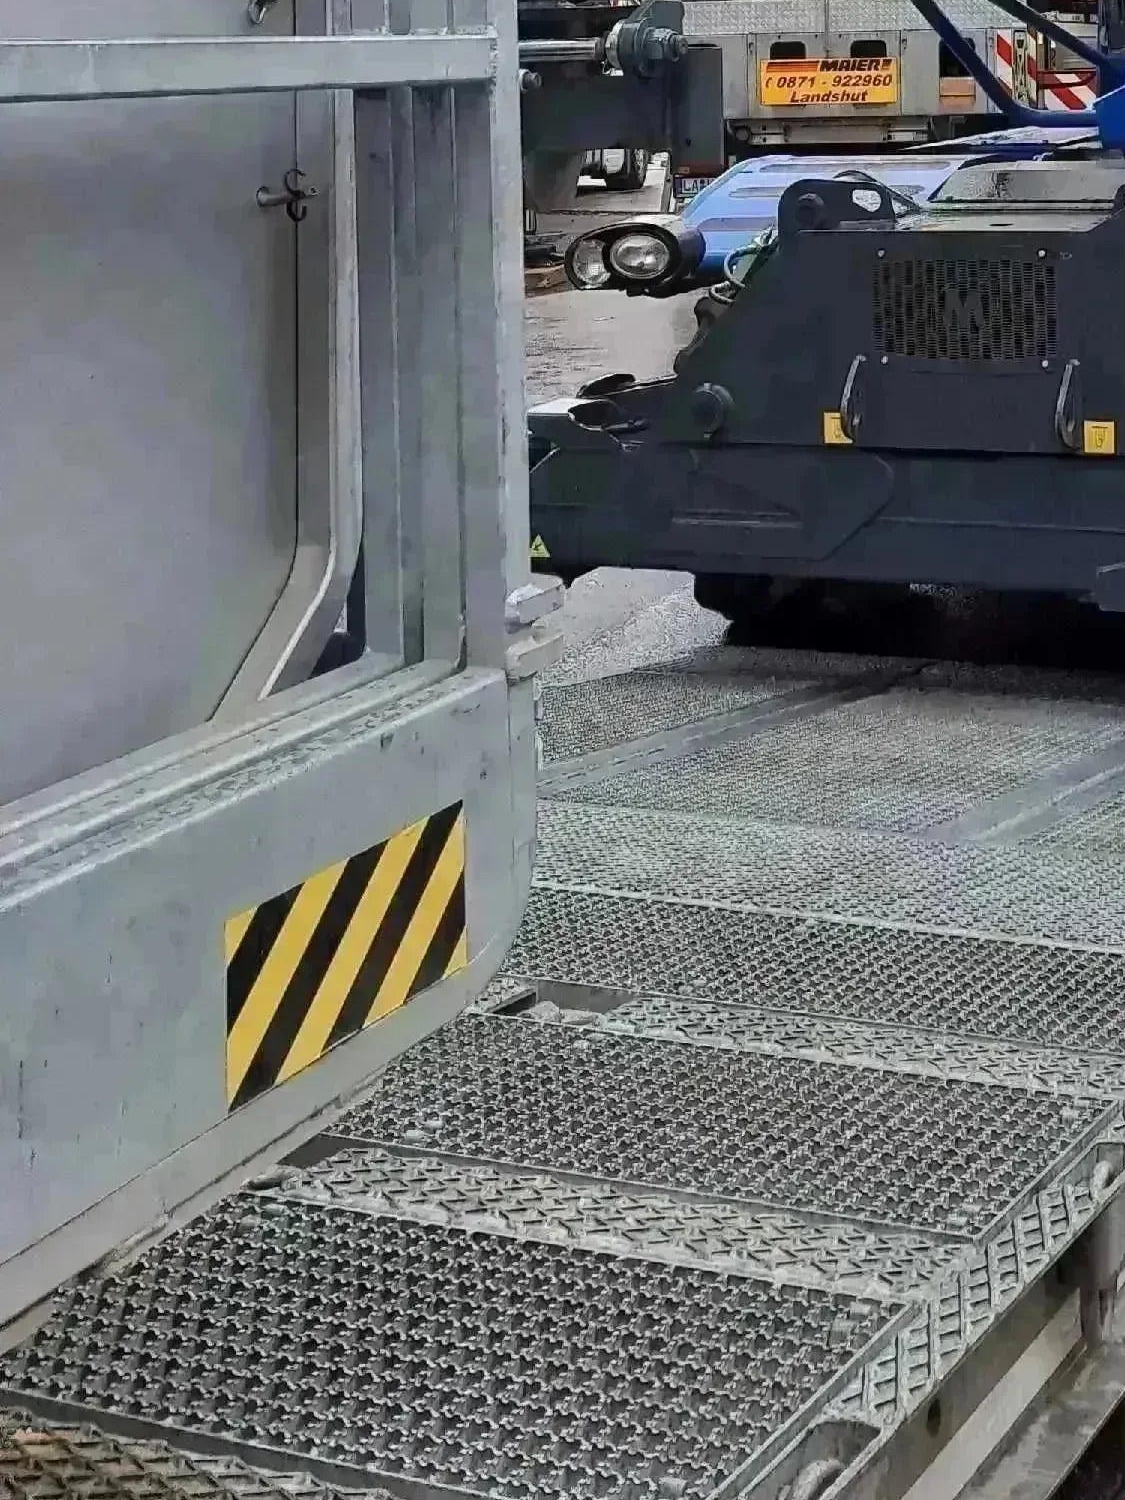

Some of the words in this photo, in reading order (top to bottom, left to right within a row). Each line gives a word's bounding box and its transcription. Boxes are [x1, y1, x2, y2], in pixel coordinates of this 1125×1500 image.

[820, 59, 881, 72] MAIER
[776, 76, 816, 89] 0871
[831, 74, 893, 88] 922960
[790, 89, 869, 103] Landshut
